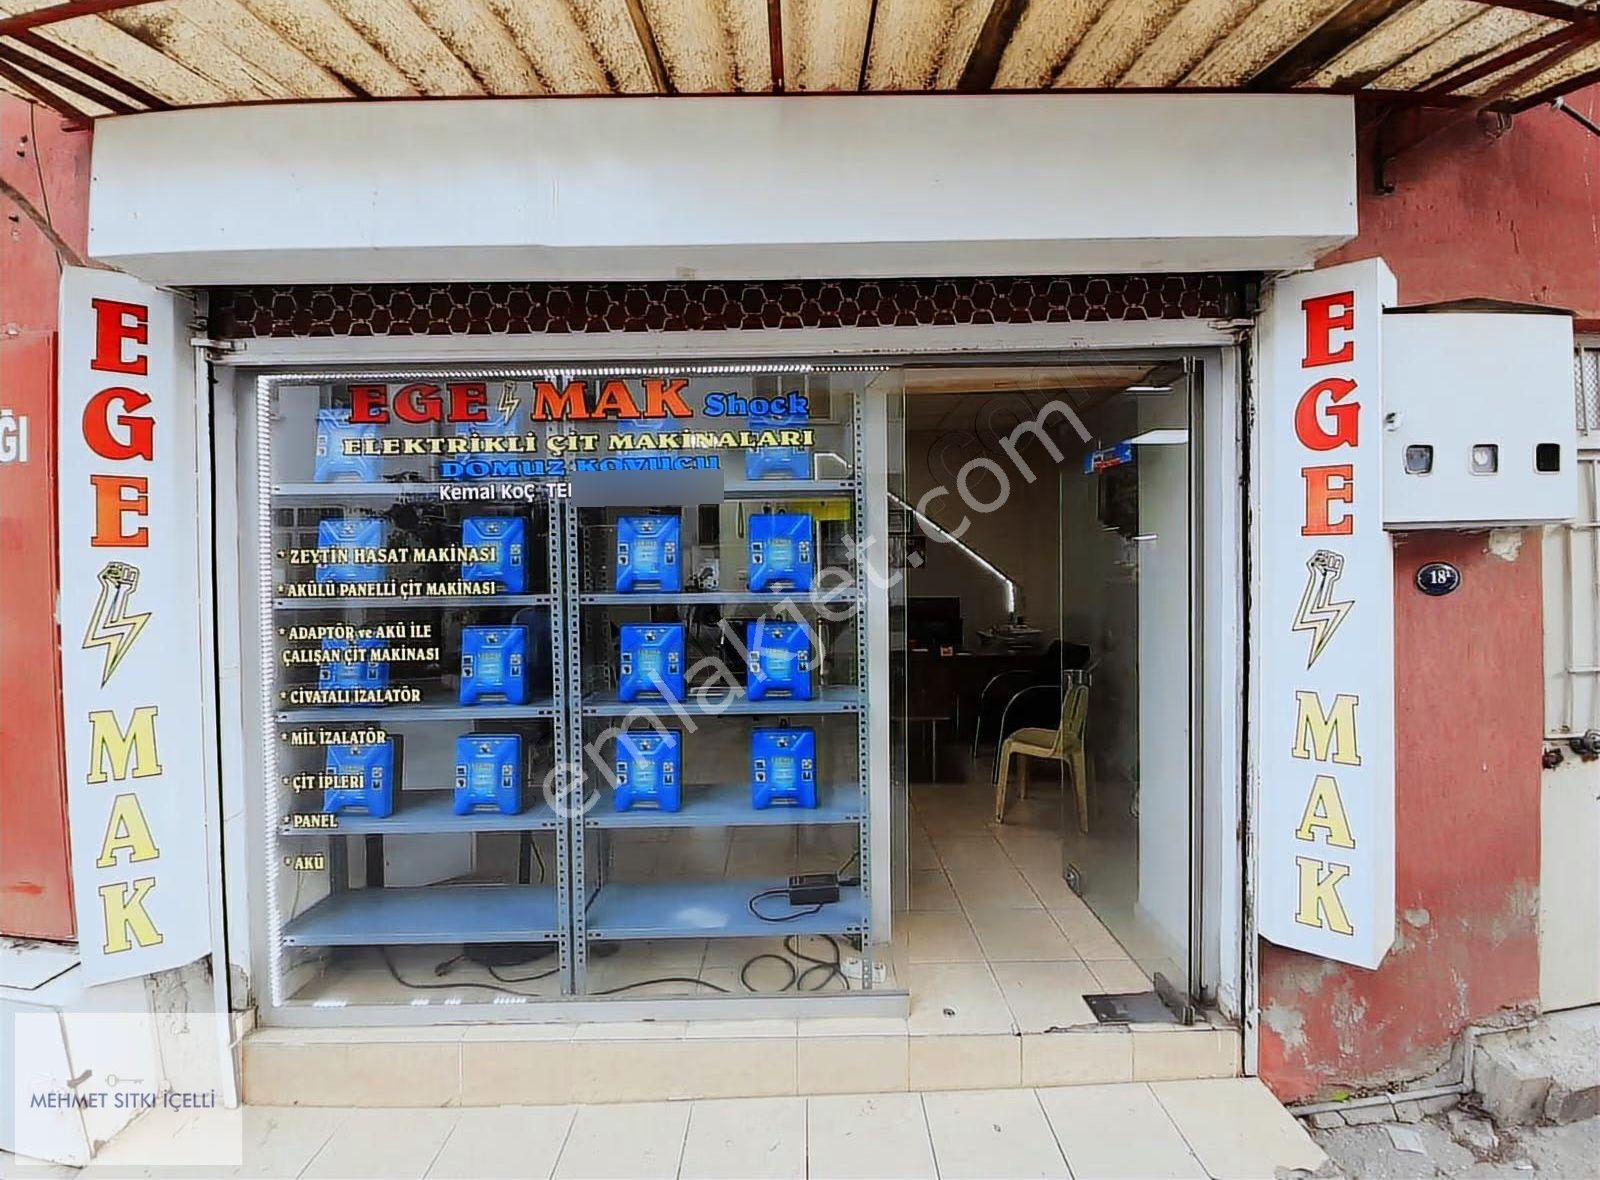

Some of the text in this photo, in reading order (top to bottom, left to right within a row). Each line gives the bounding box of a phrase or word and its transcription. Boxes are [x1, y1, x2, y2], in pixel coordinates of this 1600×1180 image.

[348, 378, 810, 424] EGE MAK Shock
[82, 298, 155, 547] EGE
[1295, 291, 1361, 536] EGE
[342, 428, 815, 458] ELEKTRİKLİ ÇİT MAKİNALARI
[439, 460, 567, 479] DOMUZ
[439, 484, 495, 502] Kemal
[290, 545, 497, 564] ZEYTİN HASAT MAKİNASI
[287, 579, 496, 599] AKÜLÜ PANELLİ ÇİT MAKİNASI
[288, 621, 432, 640] ADAPTÖR ve AKÜ İLE
[282, 646, 440, 667] ÇALIŞAN ÇİT MAKİNASI
[290, 685, 422, 704] CİVATALI İZALATÖR
[290, 726, 387, 745] MİL İZALATÖR
[292, 772, 314, 793] ÇİT
[318, 772, 365, 790] İPLERİ
[293, 813, 338, 829] PANEL
[1291, 690, 1362, 936] MAK
[86, 705, 163, 955] MAK
[293, 852, 325, 870] AKÜ
